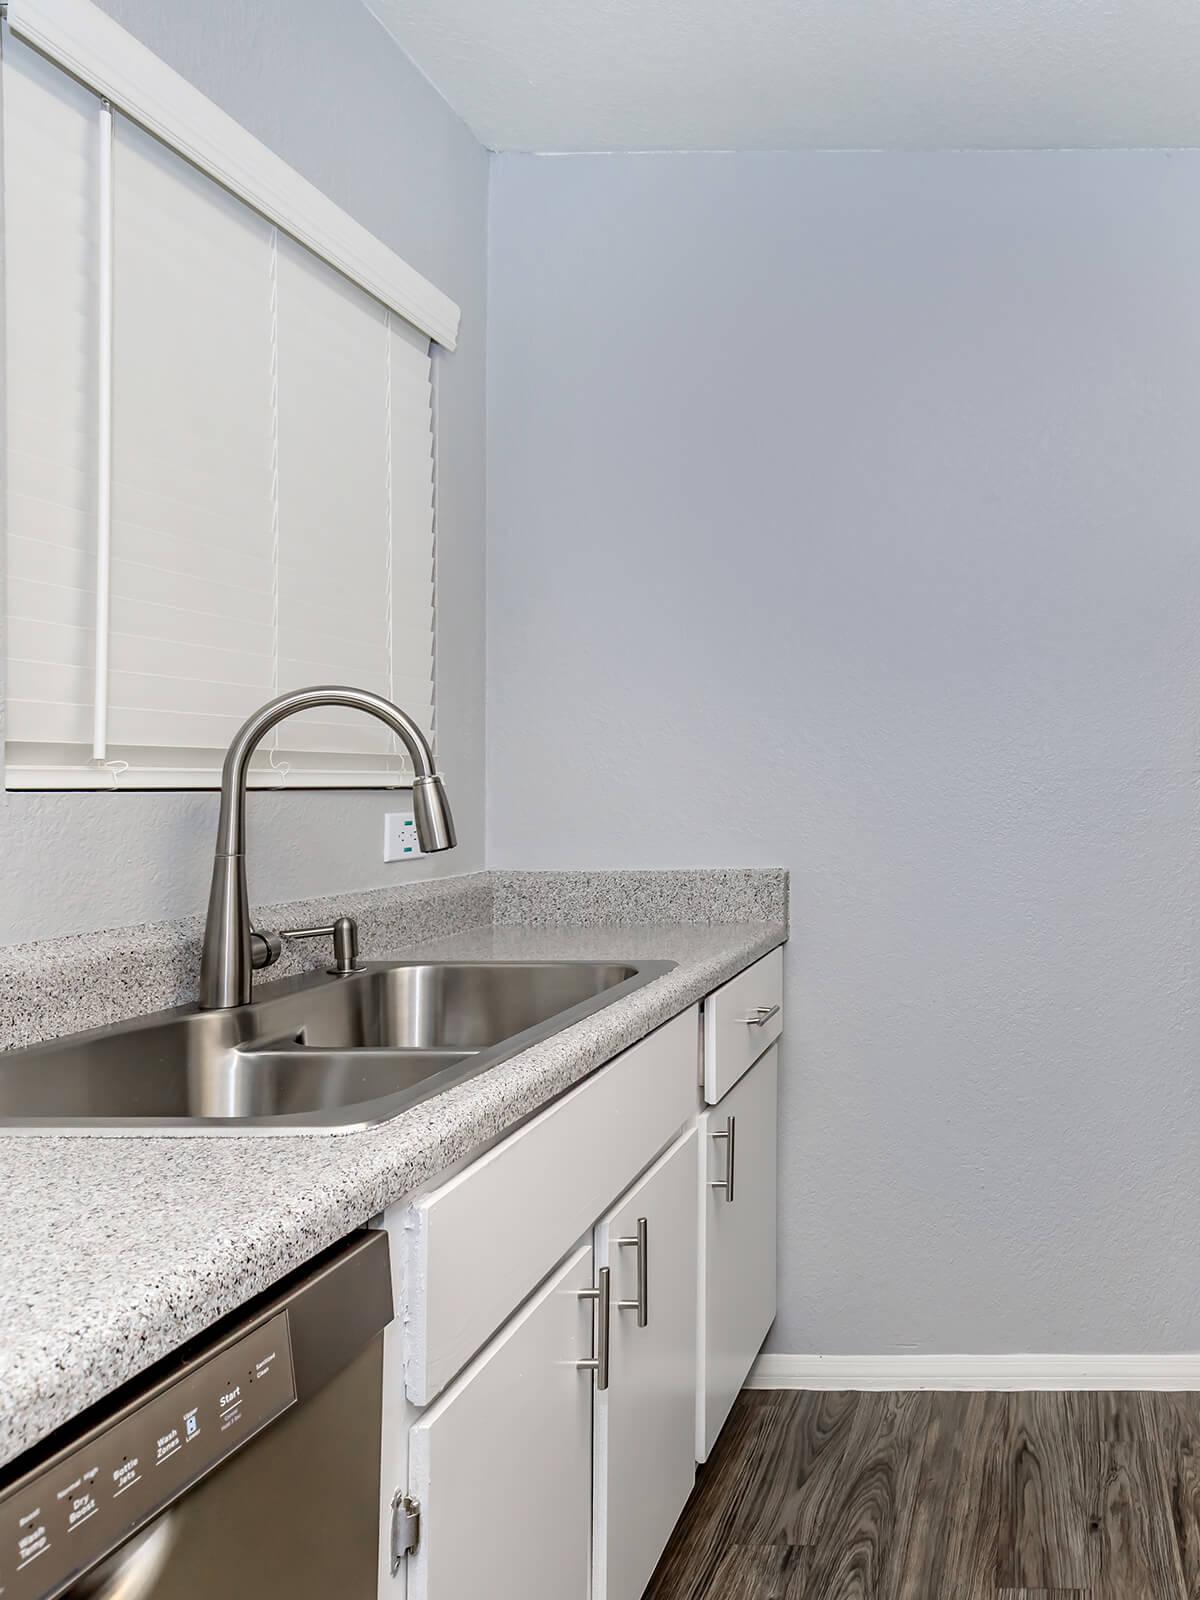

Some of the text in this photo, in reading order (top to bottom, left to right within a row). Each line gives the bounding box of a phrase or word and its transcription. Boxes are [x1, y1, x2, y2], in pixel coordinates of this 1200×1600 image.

[219, 1386, 241, 1408] Start
[156, 1429, 178, 1448] Wash
[156, 1437, 180, 1458] Zones
[113, 1458, 139, 1481] Bottle
[118, 1469, 136, 1487] Jets
[69, 1499, 96, 1524] Boost
[73, 1494, 90, 1511] Dry
